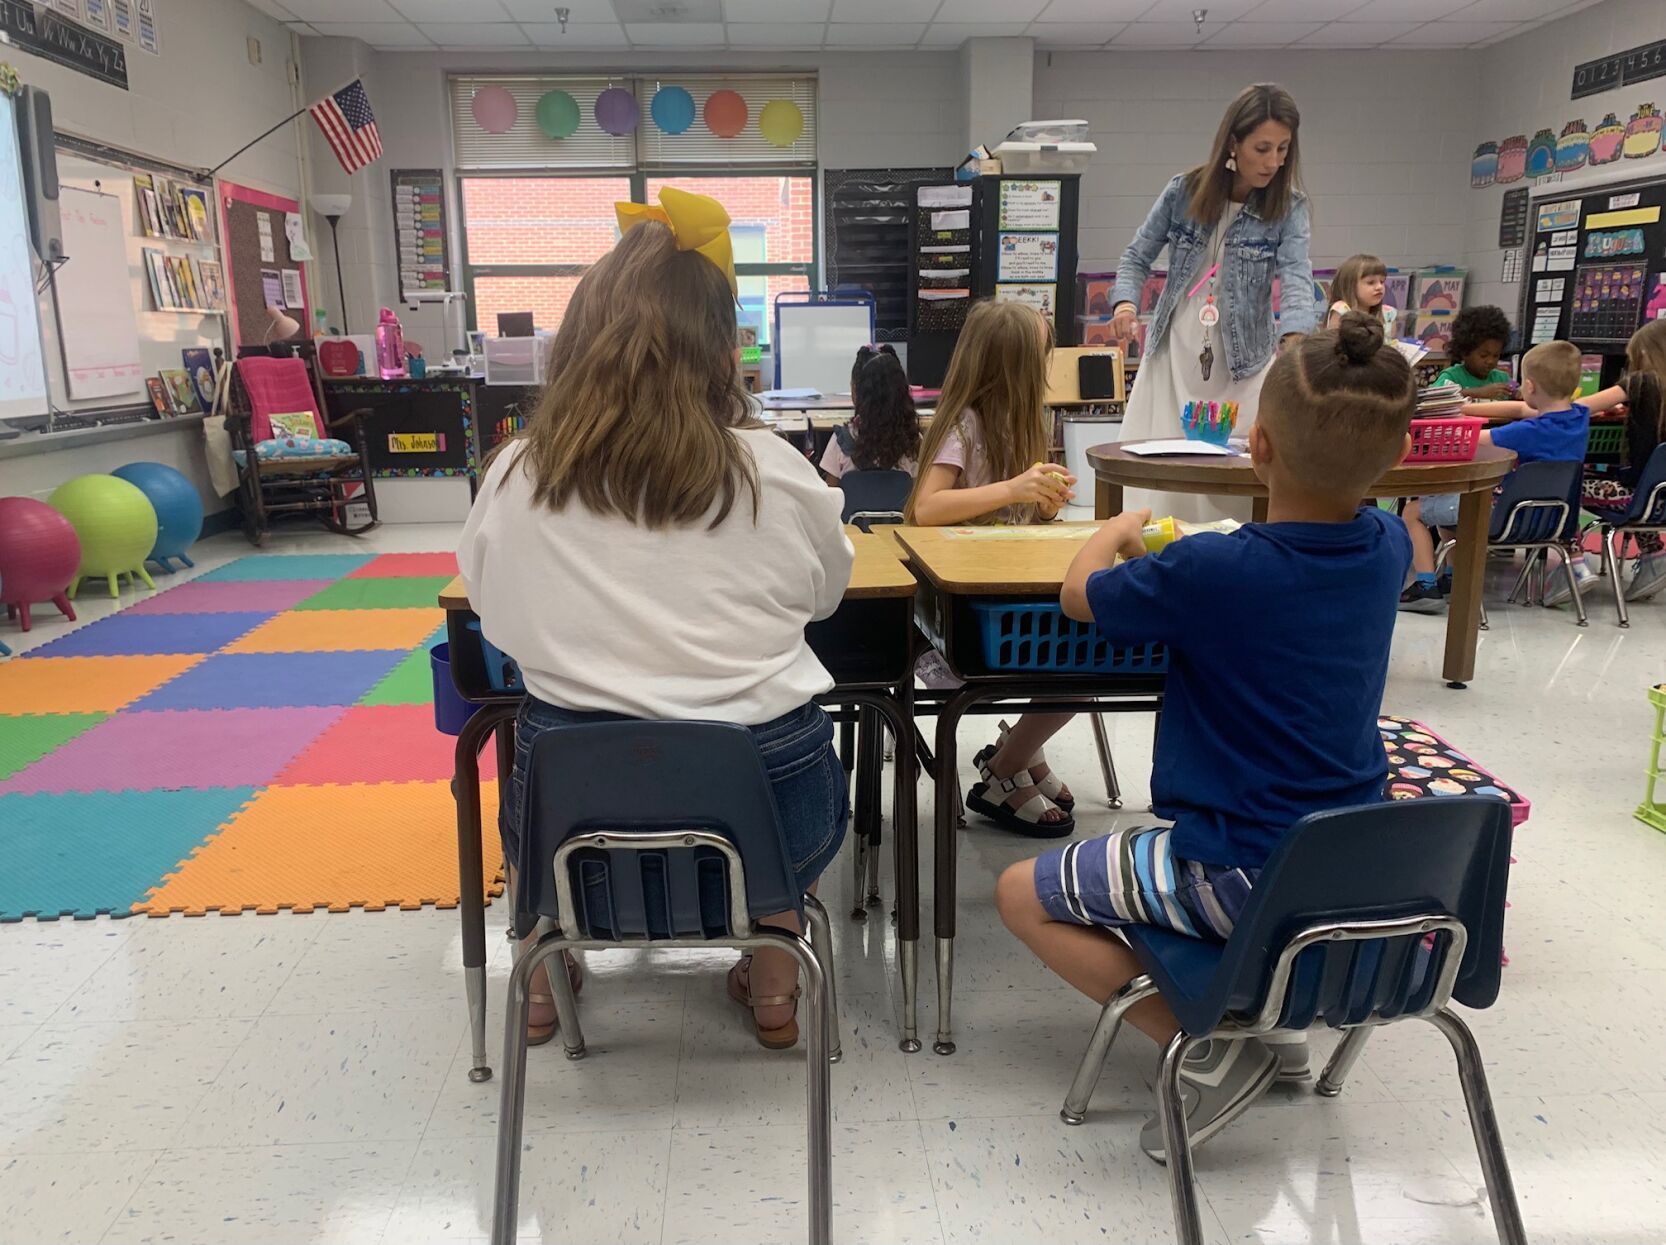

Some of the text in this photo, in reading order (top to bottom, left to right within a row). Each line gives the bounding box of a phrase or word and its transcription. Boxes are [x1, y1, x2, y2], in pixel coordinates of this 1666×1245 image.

[15, 7, 34, 35] Uu
[43, 18, 54, 41] Vv
[57, 24, 76, 52] Ww
[79, 35, 94, 59] Xx
[95, 42, 109, 73] Yy
[112, 49, 126, 72] Zz
[1578, 70, 1586, 86] 0
[1600, 63, 1608, 79] 2
[1612, 60, 1620, 75] 3
[1628, 55, 1635, 71] 4
[1641, 51, 1649, 67] 5
[1654, 48, 1661, 64] 6
[1443, 280, 1461, 292] MAY
[1440, 322, 1454, 332] MA
